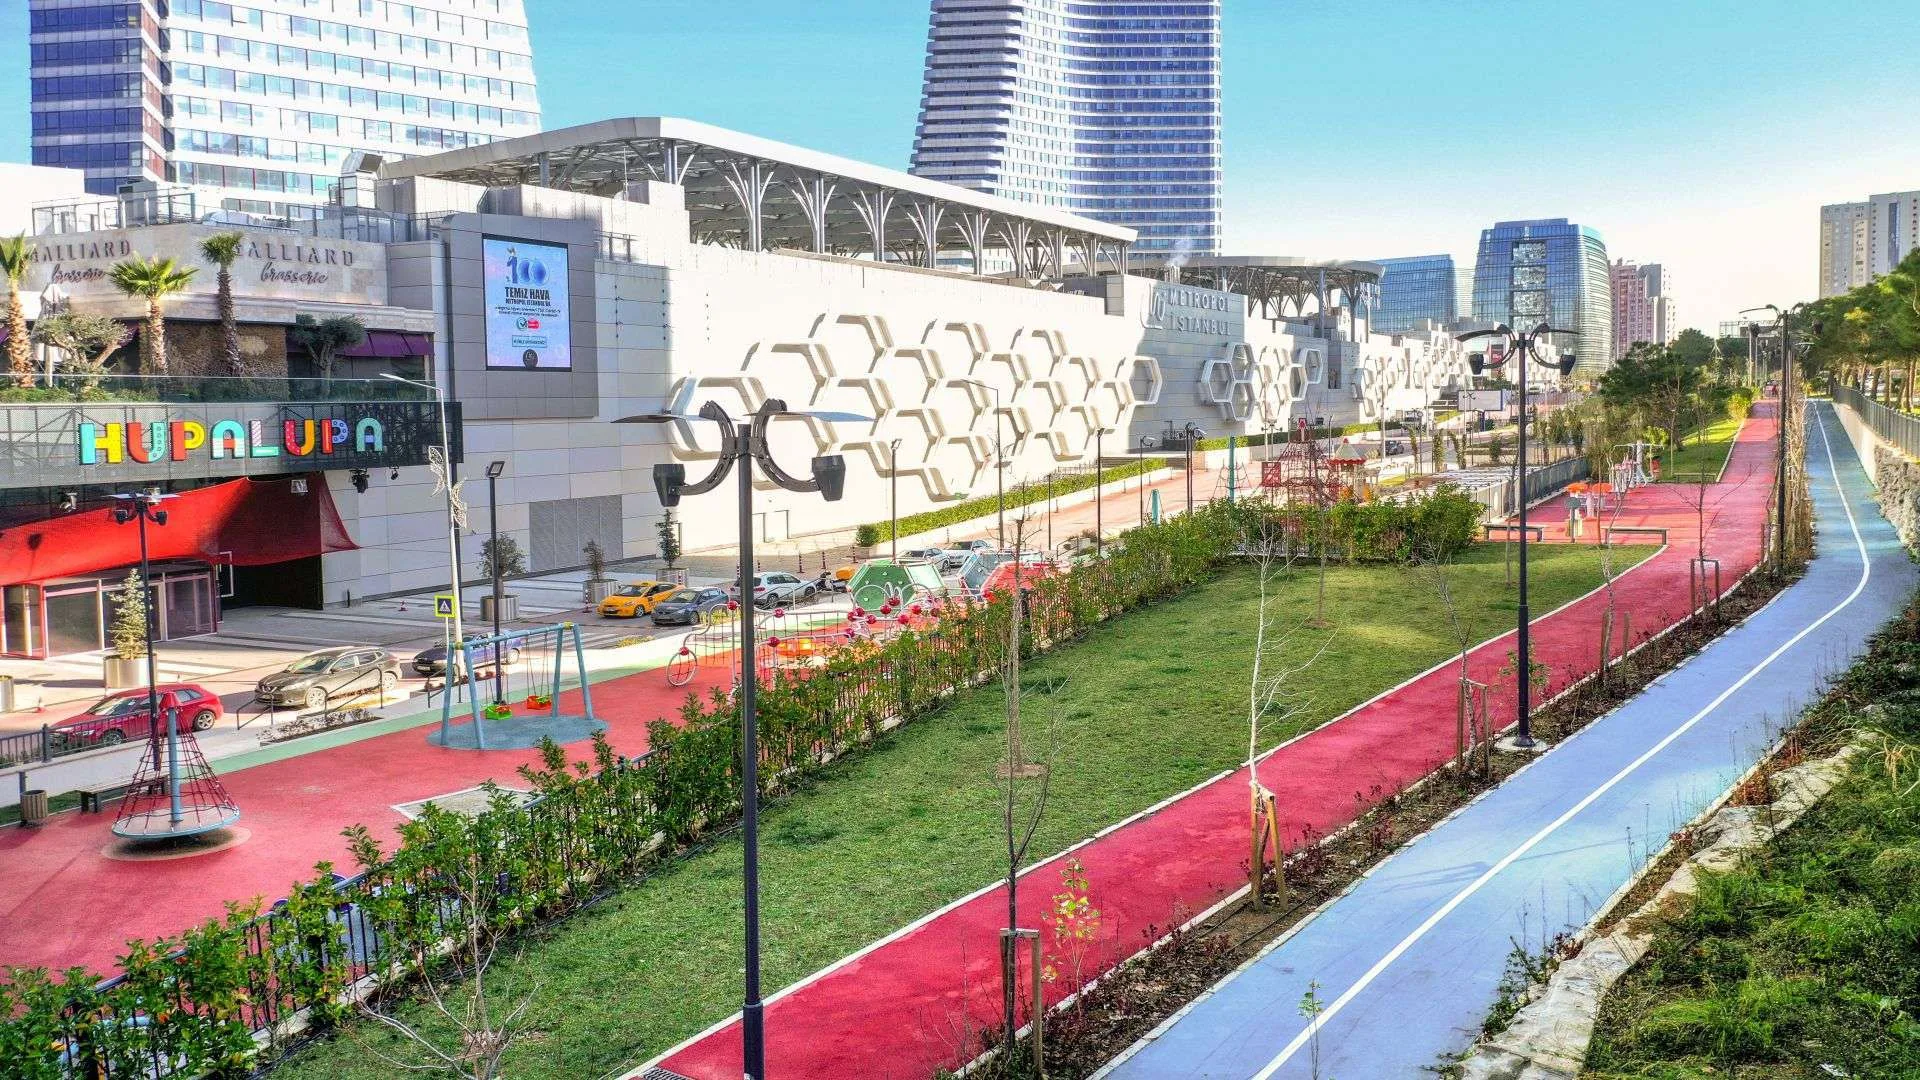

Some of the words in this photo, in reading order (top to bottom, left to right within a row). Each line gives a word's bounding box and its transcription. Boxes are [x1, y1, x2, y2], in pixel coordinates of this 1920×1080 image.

[260, 261, 328, 284] brasserie
[529, 288, 550, 301] HAVA
[1169, 286, 1230, 312] METROPOL
[78, 416, 384, 465] HUPALUPA
